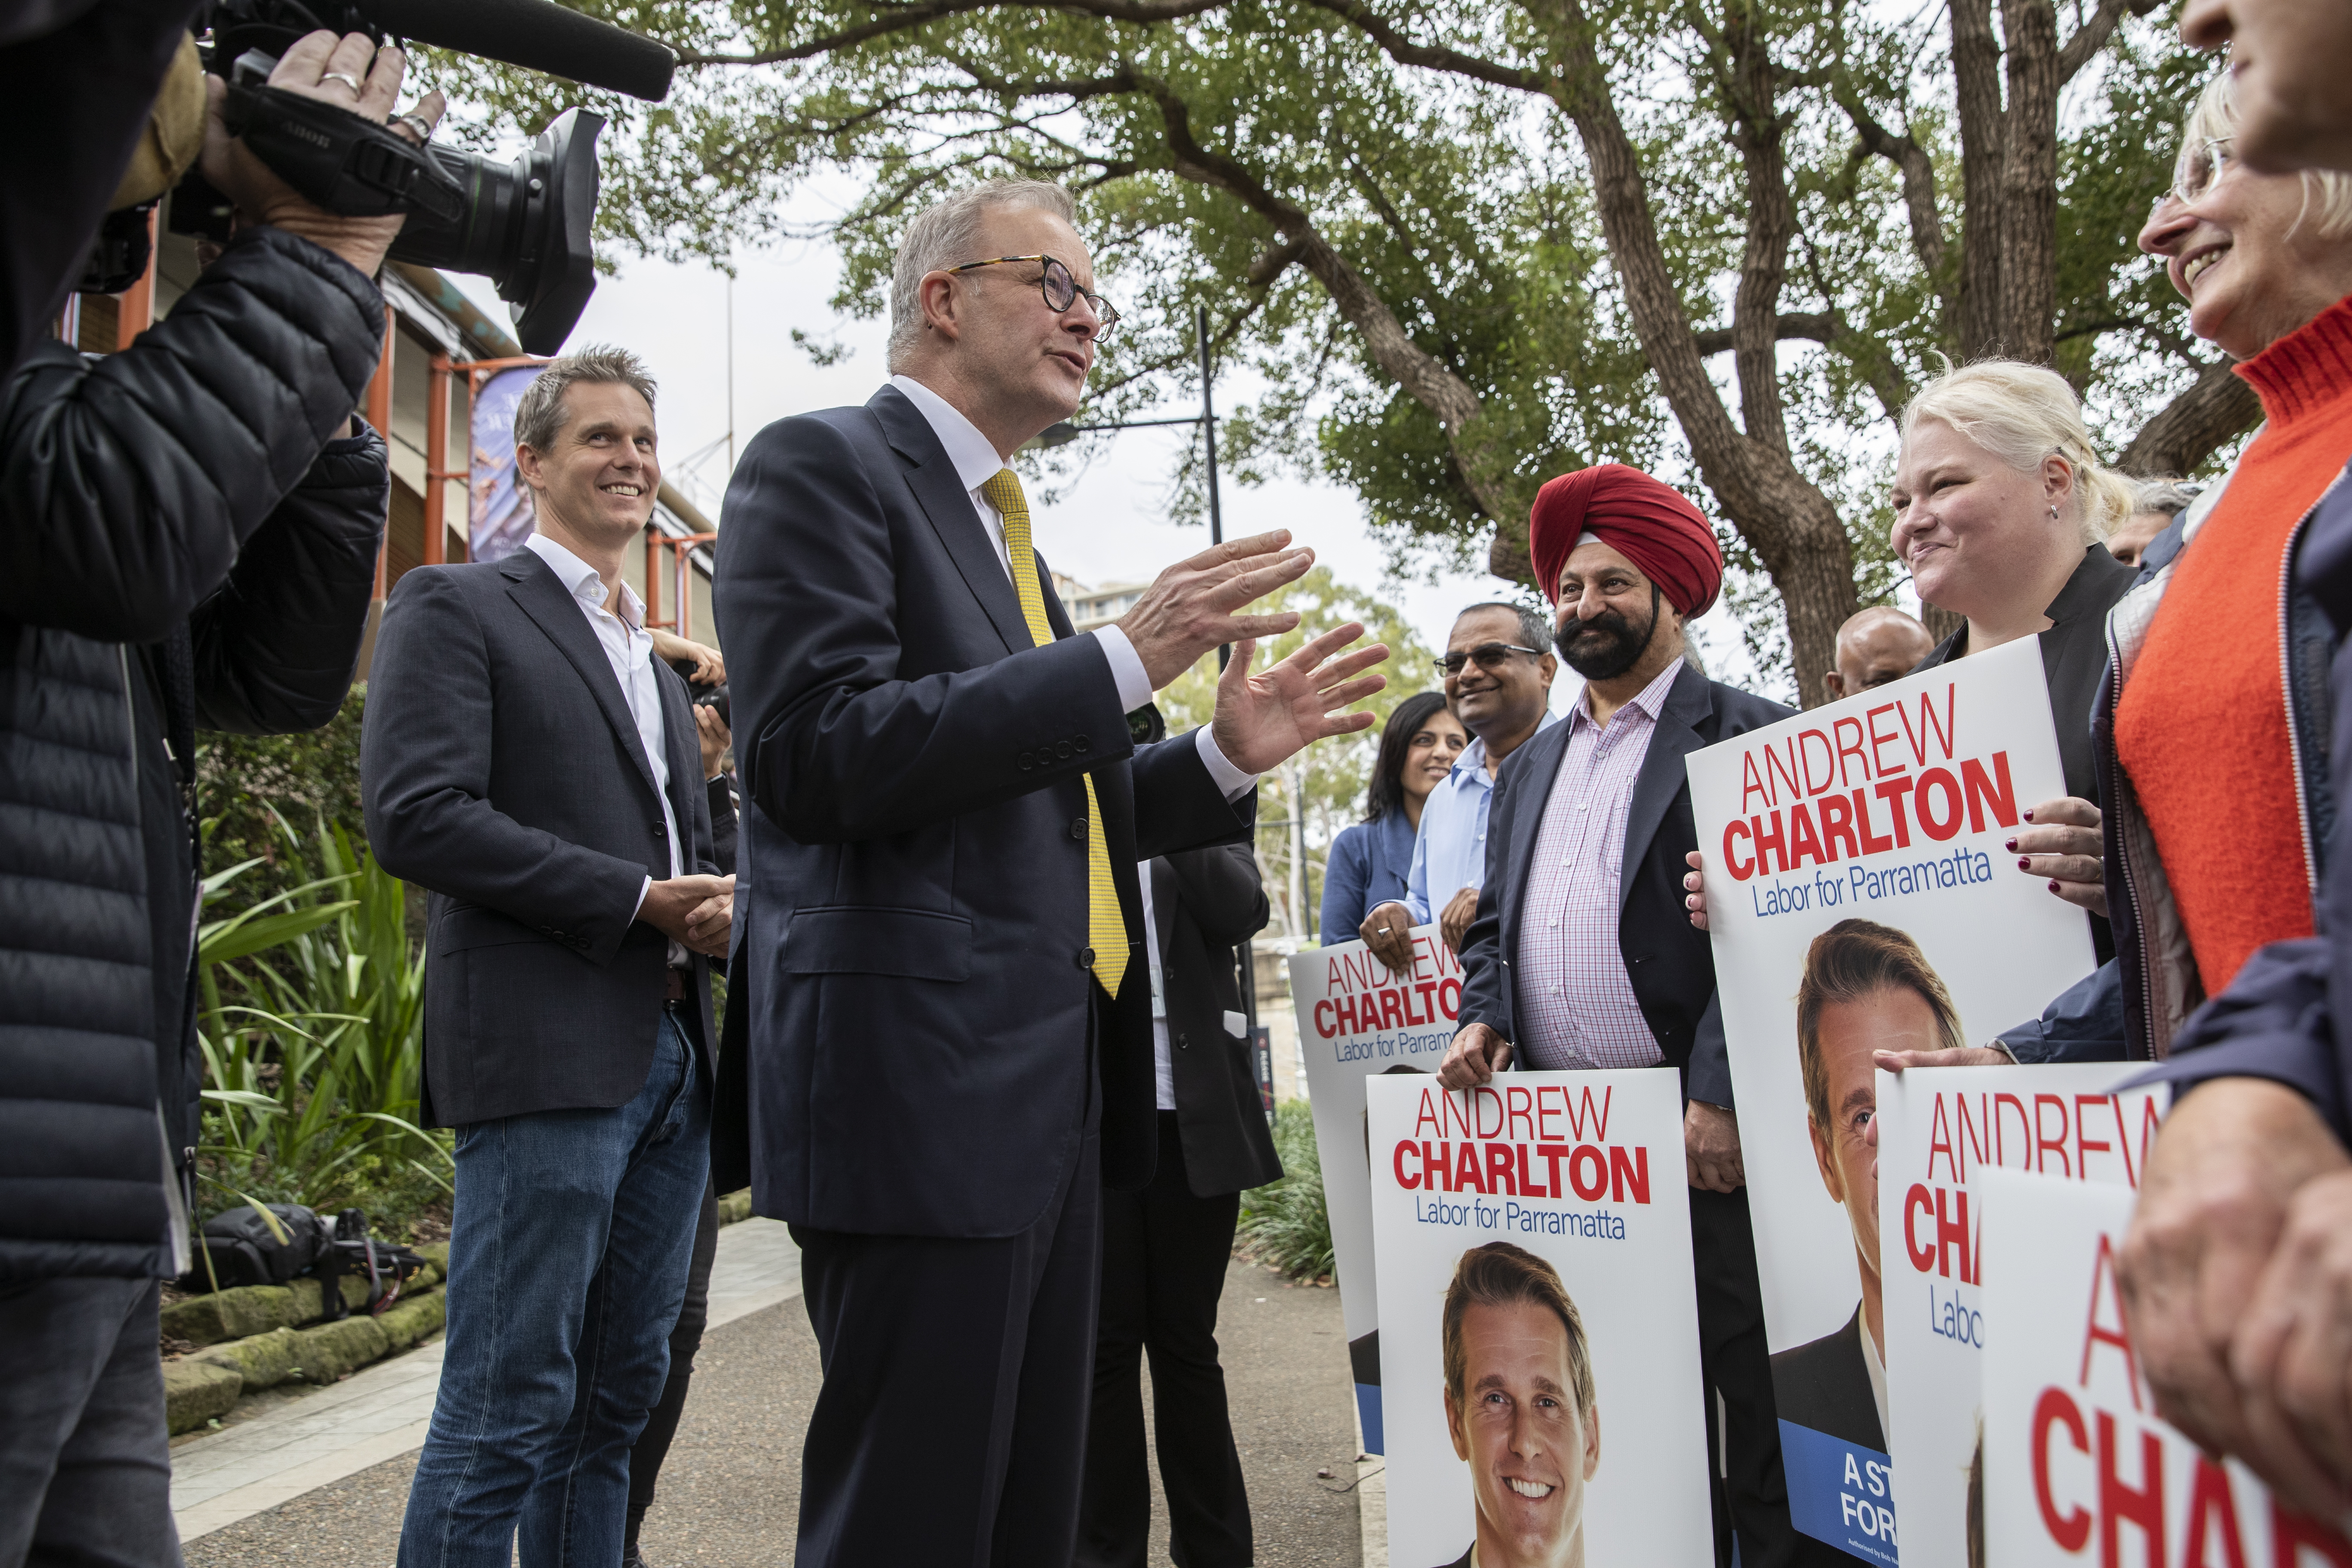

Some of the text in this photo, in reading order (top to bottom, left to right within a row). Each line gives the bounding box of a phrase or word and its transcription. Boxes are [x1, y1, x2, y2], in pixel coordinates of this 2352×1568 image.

[1743, 683, 1955, 814] ANDREW
[1722, 750, 2019, 881] CHARLTON
[1752, 846, 1993, 918] Labor for Parramatta
[1328, 936, 1462, 997] ANDEW
[1313, 977, 1463, 1039] CHARLTO
[1334, 1032, 1455, 1063] Labor for Parram
[1415, 1085, 1612, 1142] ANDREW
[1393, 1139, 1651, 1204] CHARLTON
[1416, 1195, 1626, 1240] Labor for Parramatta
[1903, 1182, 1982, 1286] CH
[1844, 1452, 1864, 1491] A
[1840, 1491, 1898, 1547] FOR
[1848, 1538, 1874, 1555] Authorised
[1874, 1548, 1880, 1559] by
[1880, 1552, 1891, 1562] Bob
